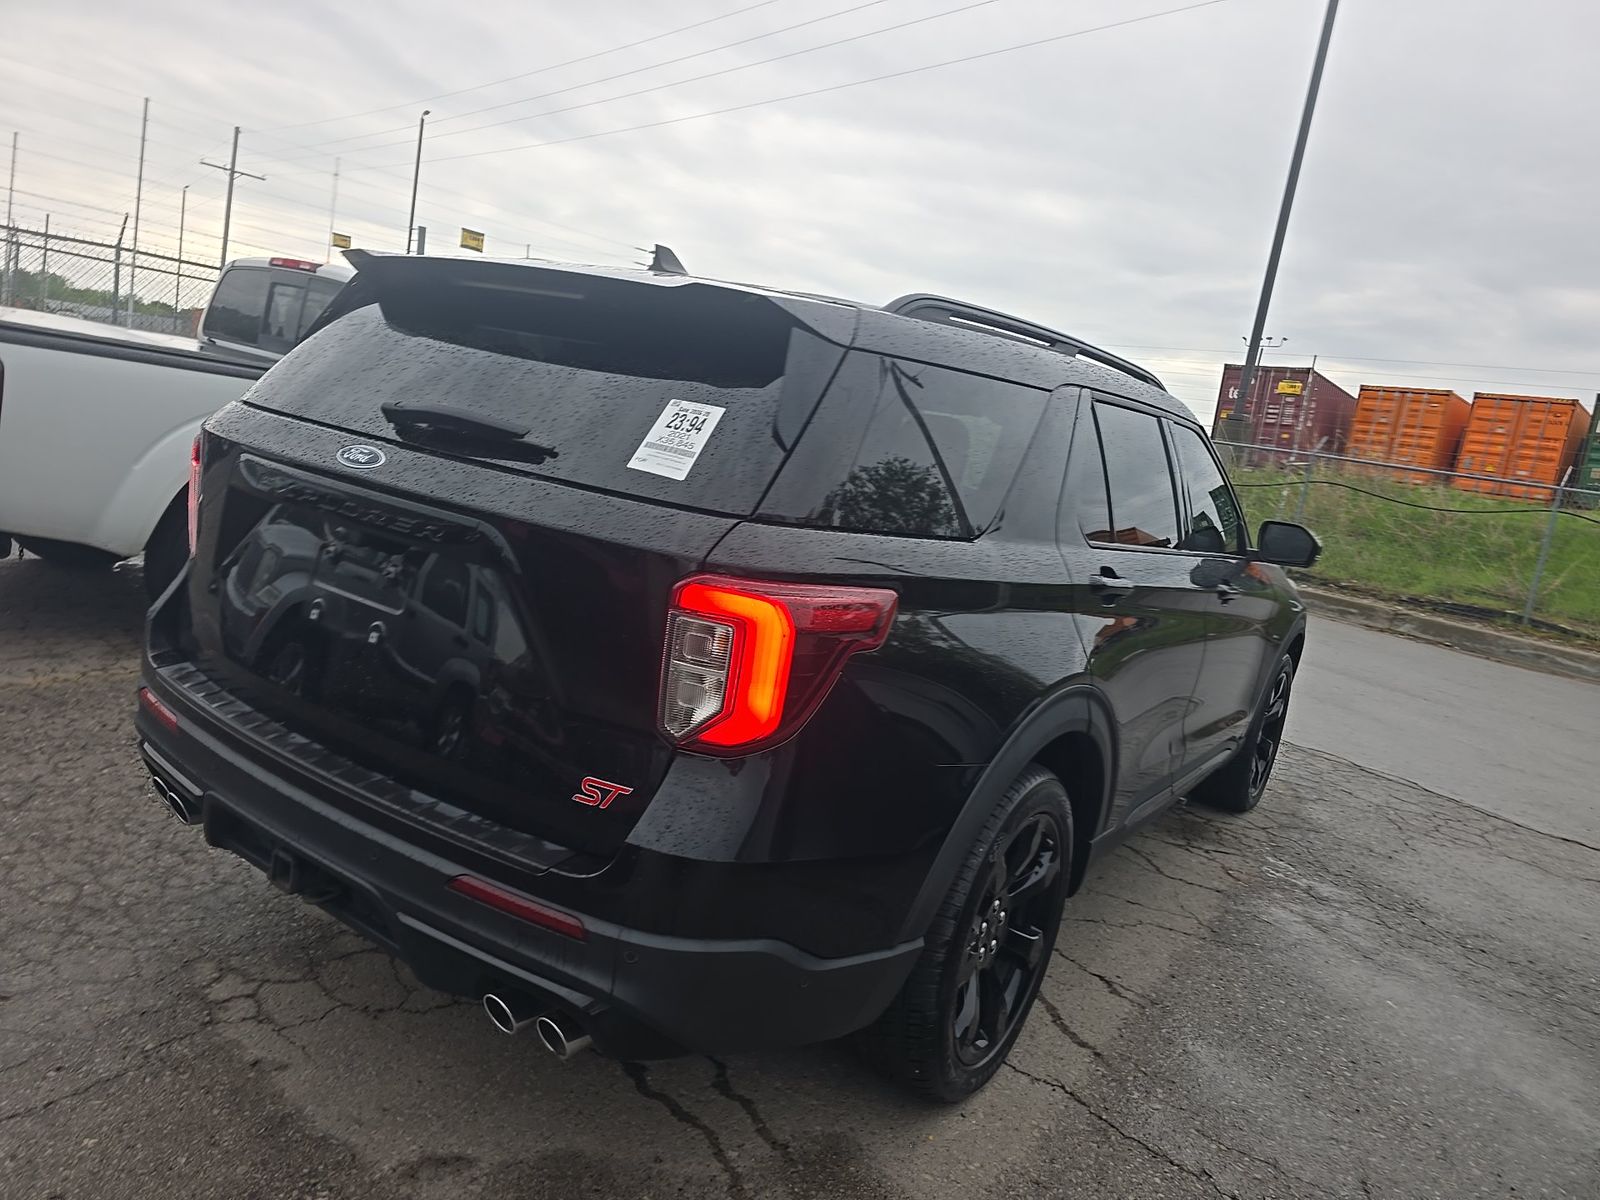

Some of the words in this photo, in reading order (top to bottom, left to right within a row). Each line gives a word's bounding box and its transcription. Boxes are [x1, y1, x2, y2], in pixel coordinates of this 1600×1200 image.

[665, 412, 708, 434] 23:94
[667, 430, 691, 441] 2021
[571, 776, 634, 809] ST
